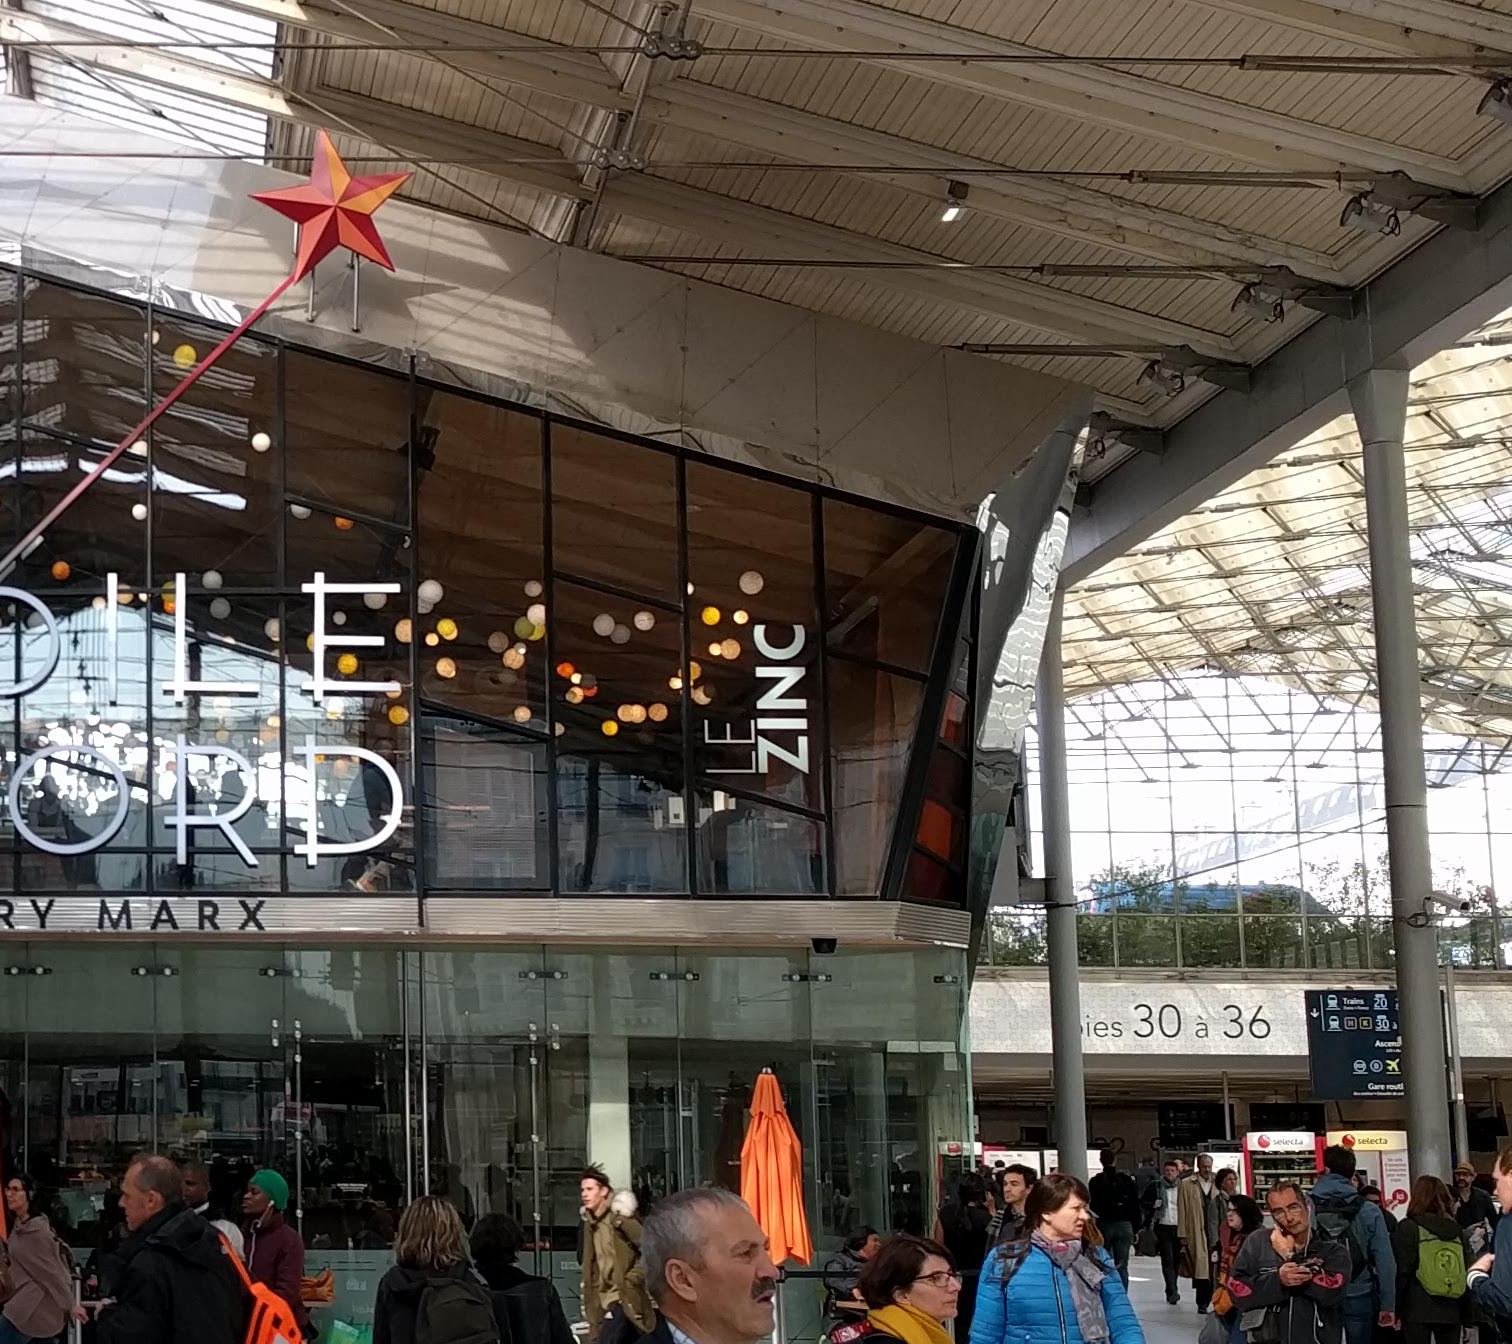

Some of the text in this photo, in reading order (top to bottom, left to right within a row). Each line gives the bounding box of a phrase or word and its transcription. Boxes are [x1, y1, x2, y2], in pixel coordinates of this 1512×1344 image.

[753, 624, 810, 775] ZINC
[704, 719, 756, 774] LE
[96, 899, 266, 931] MARX
[1342, 997, 1365, 1005] Trains
[1373, 997, 1389, 1008] 20
[1080, 1003, 1272, 1040] ies 30 à 36
[1375, 1019, 1390, 1030] 30
[1368, 1082, 1385, 1091] Gare
[1272, 1137, 1304, 1146] selecta
[1357, 1137, 1389, 1145] selecta
